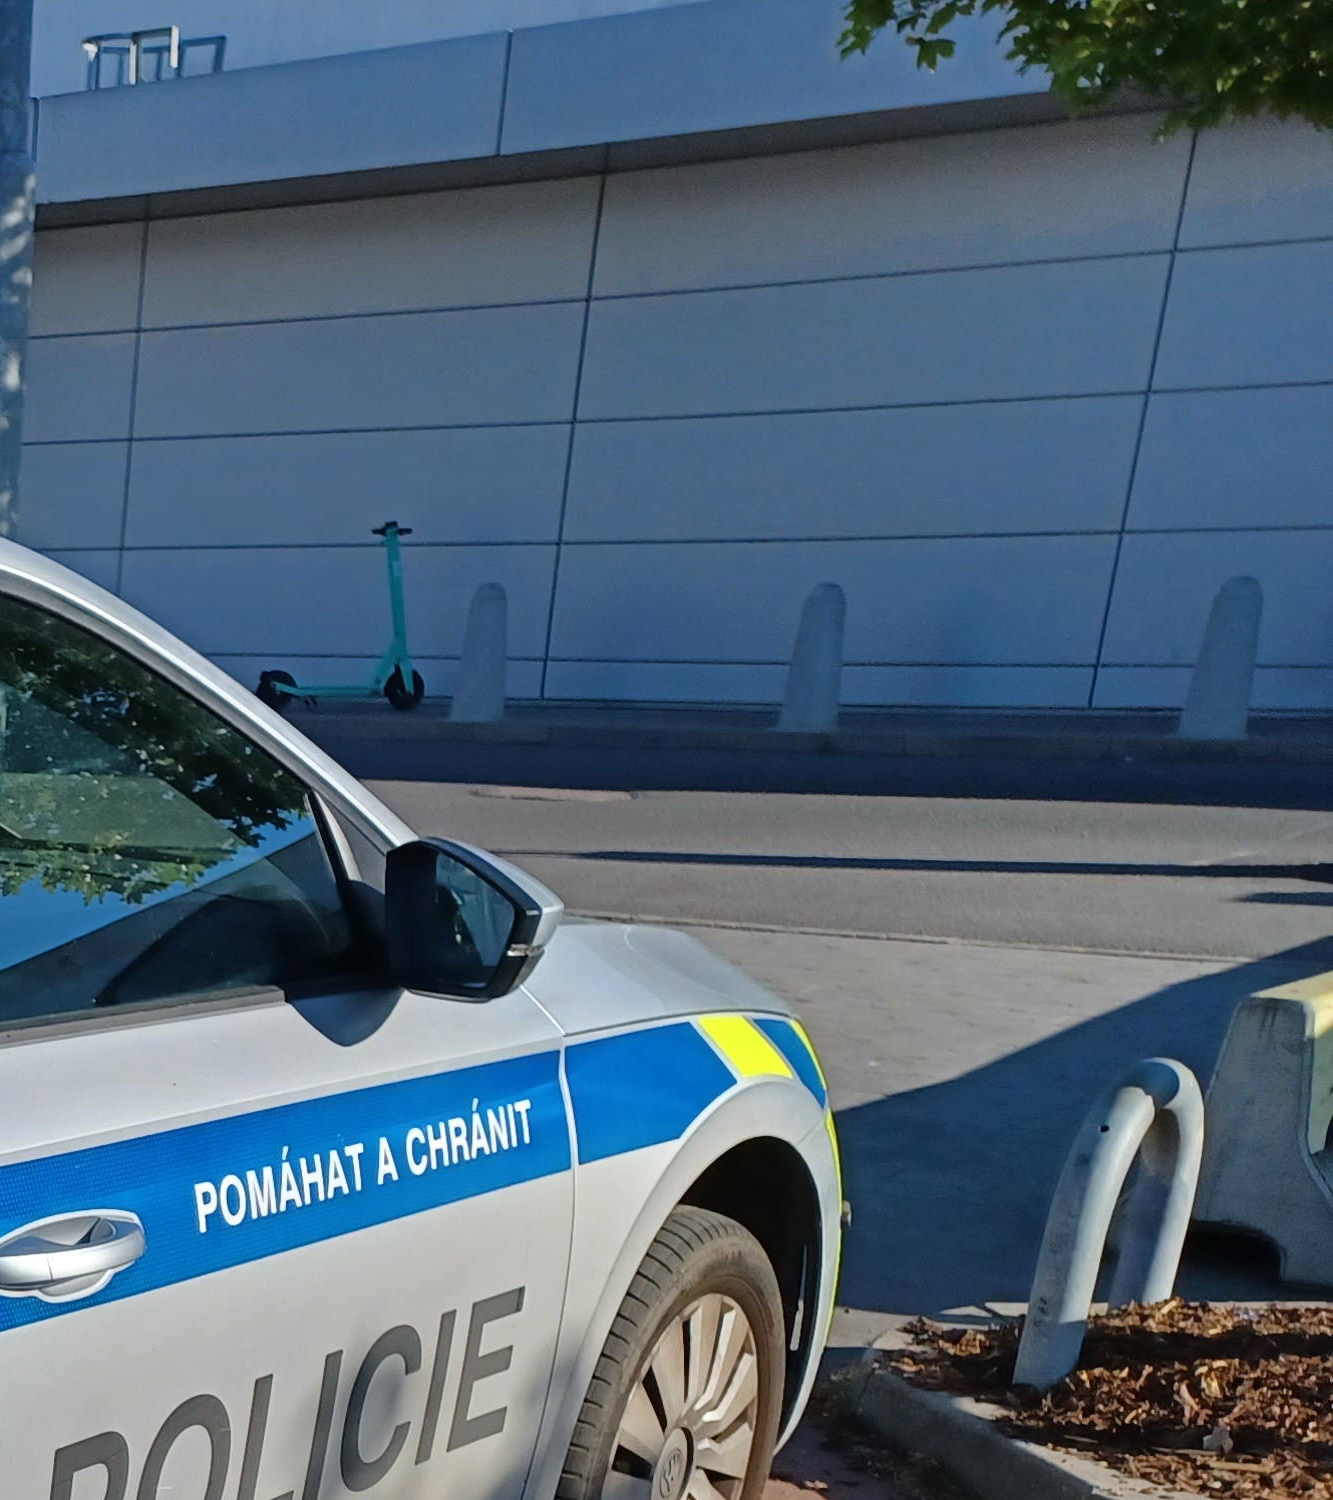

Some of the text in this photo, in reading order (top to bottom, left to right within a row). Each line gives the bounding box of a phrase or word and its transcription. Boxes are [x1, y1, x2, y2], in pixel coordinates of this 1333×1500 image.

[194, 1098, 532, 1233] POMÁHAT A CHRÁNIT
